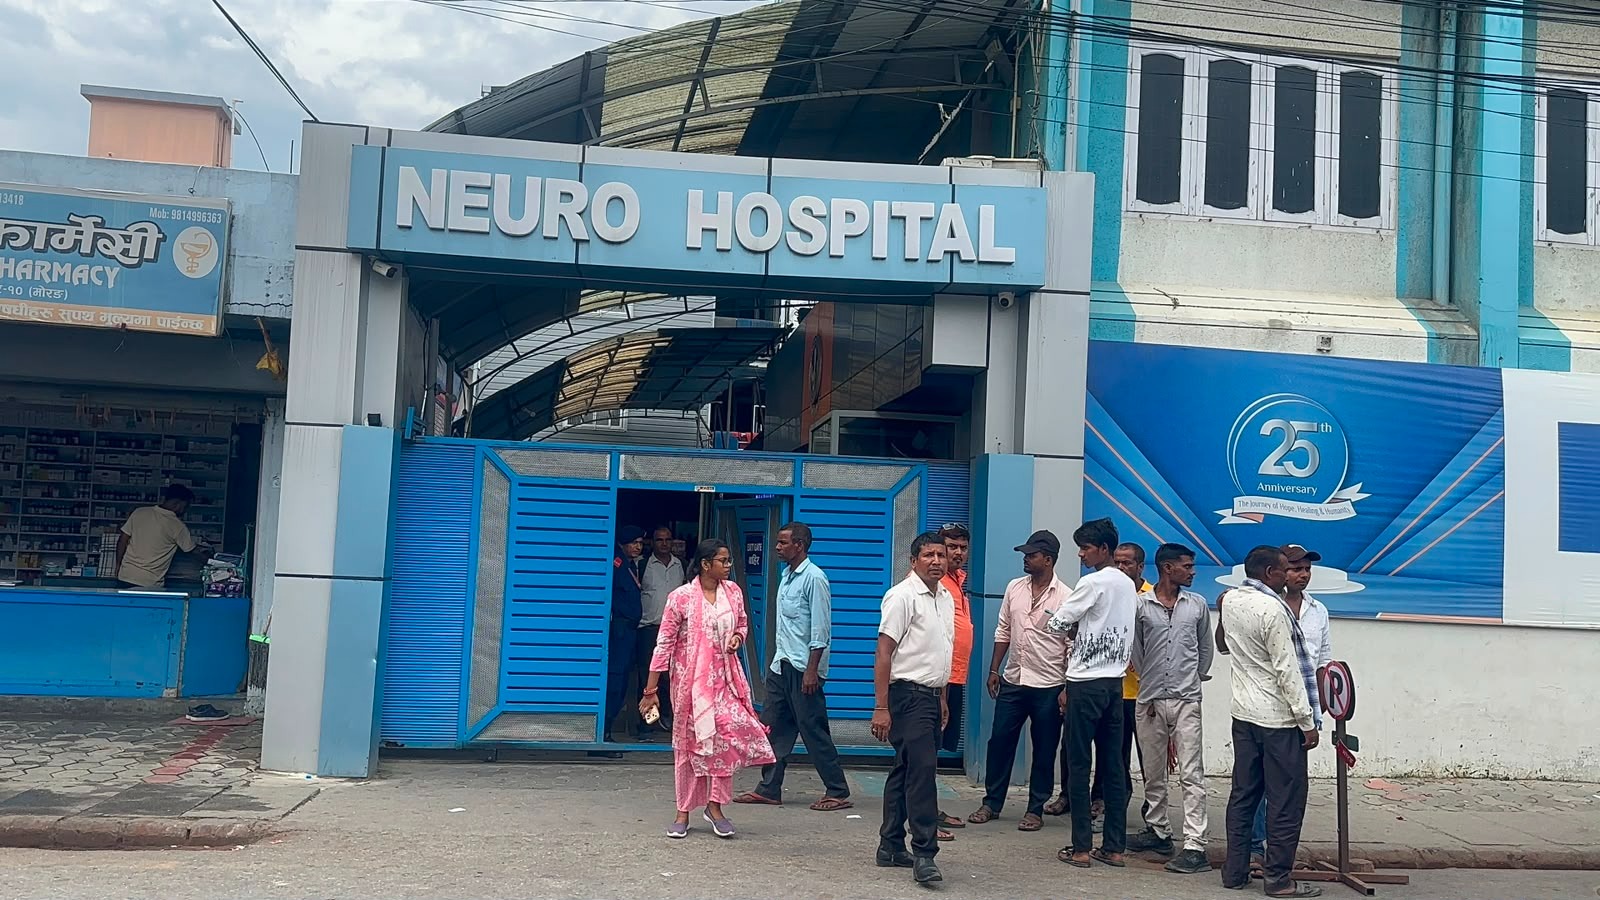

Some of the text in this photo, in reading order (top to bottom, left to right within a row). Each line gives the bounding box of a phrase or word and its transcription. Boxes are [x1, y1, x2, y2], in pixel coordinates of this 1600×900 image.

[149, 207, 222, 223] Mob: 9814996363
[396, 165, 1016, 263] NEURO HOSPITAL
[28, 285, 68, 300] (मोरङ)
[1257, 482, 1318, 497] Anniversary
[1238, 500, 1249, 508] The
[1250, 500, 1271, 510] Journey
[1297, 505, 1319, 516] Healing
[1325, 506, 1351, 516] Humanity
[1330, 670, 1343, 709] P
